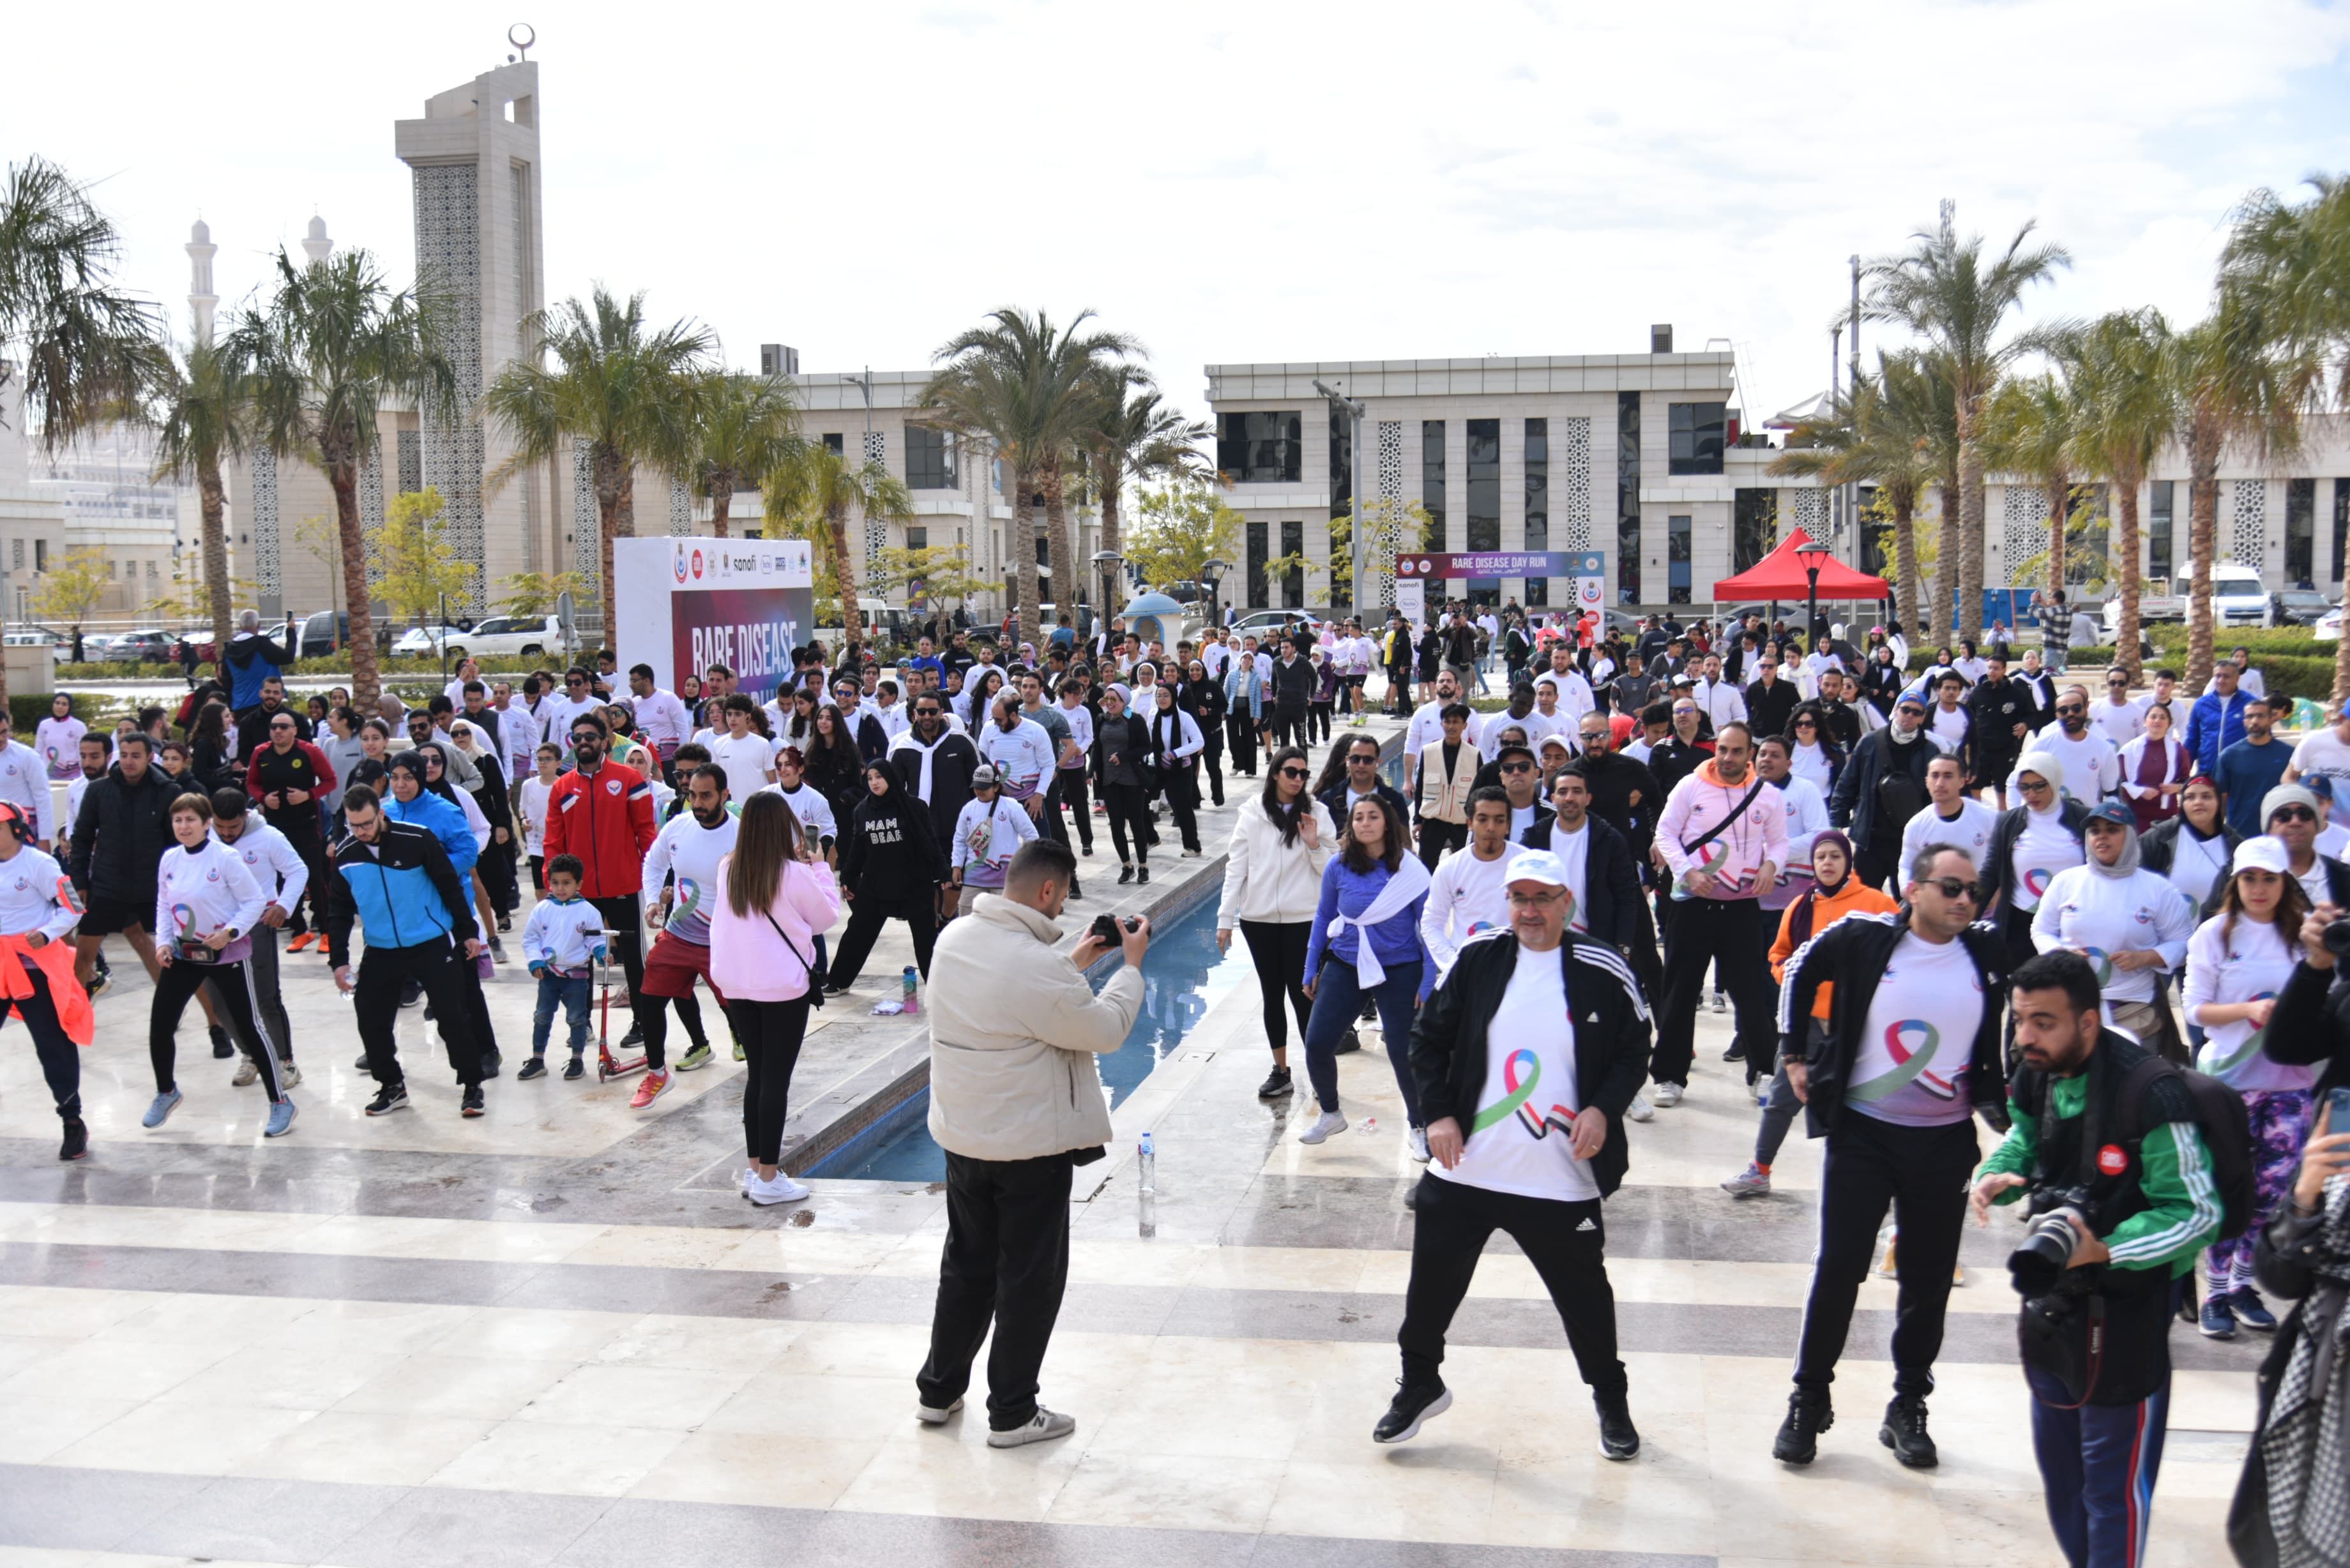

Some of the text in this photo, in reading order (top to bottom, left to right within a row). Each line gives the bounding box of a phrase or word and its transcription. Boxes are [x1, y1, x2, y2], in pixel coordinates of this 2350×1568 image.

[734, 554, 756, 571] sanofi
[1452, 557, 1547, 569] RARE DISEASE DAY RUN
[865, 818, 897, 832] MAM
